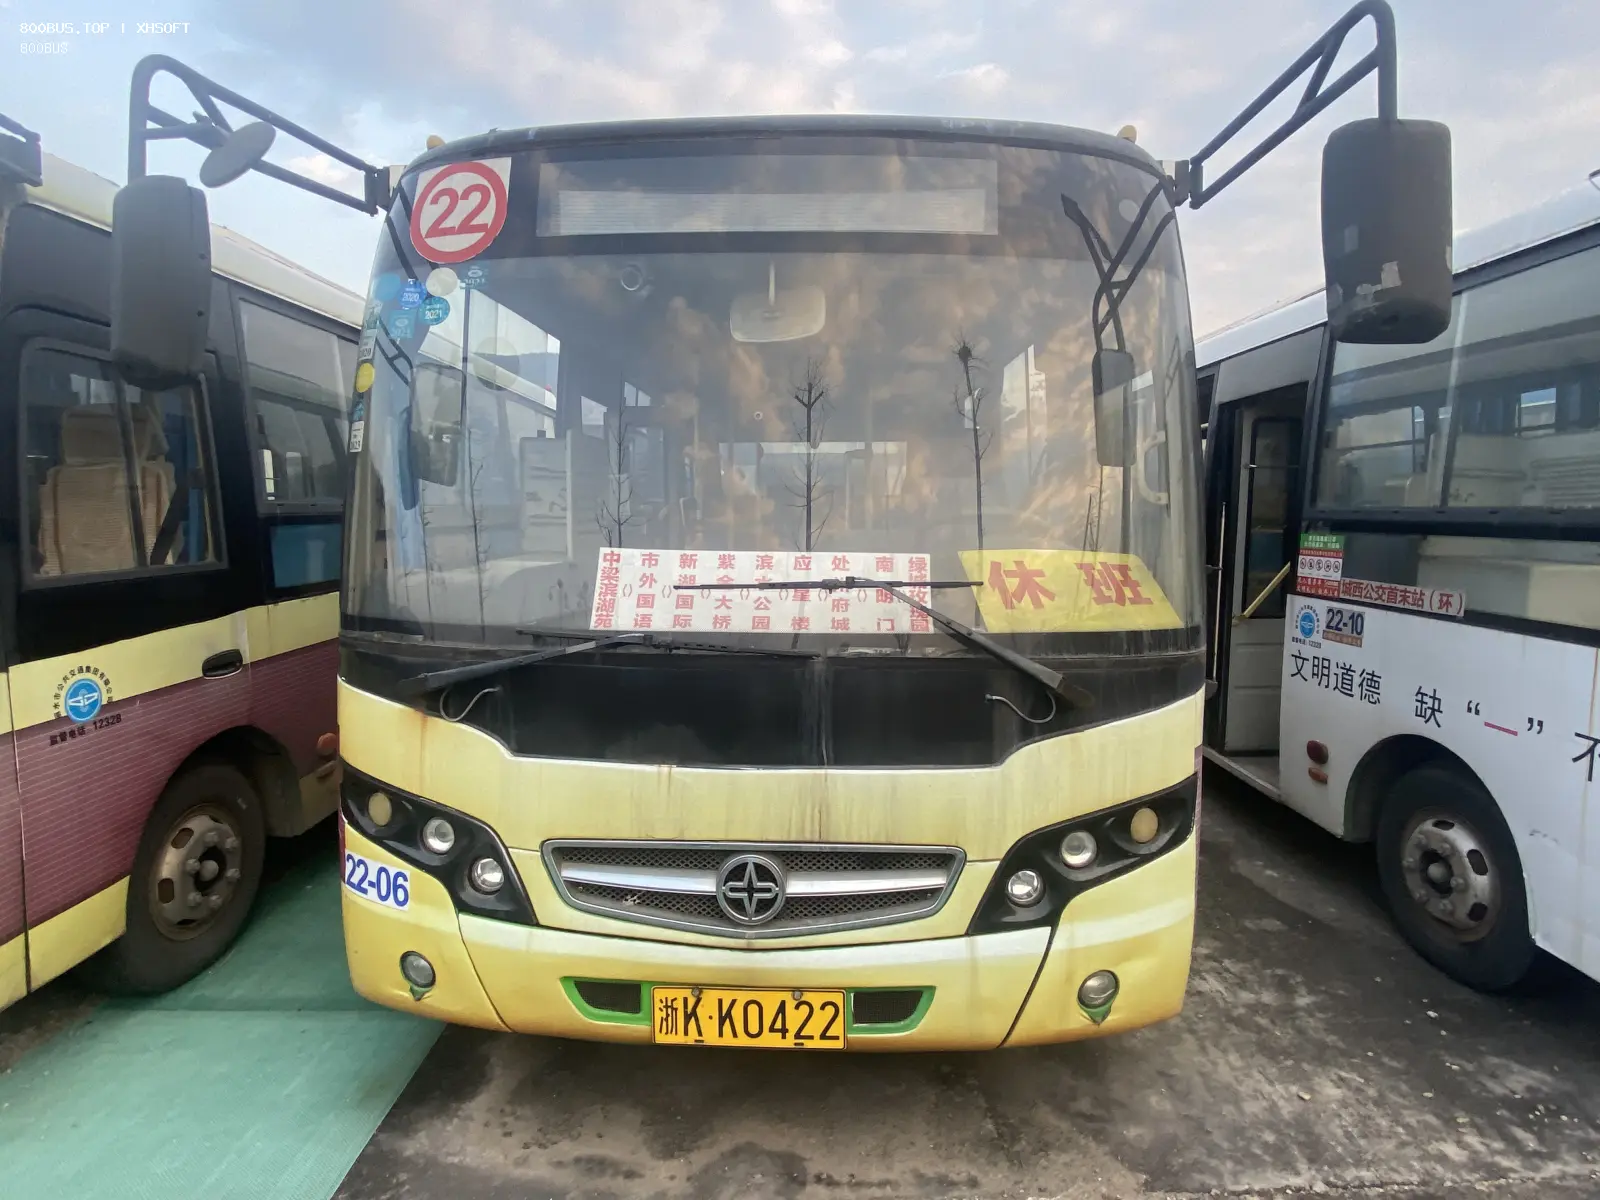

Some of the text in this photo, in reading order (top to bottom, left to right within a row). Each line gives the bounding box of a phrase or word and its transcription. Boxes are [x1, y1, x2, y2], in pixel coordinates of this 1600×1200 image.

[424, 183, 492, 239] 22
[593, 550, 621, 629] 中梁滨湖苑
[633, 552, 660, 630] 市外国语
[672, 553, 698, 629] 新湖国际
[831, 555, 851, 632] 处府城
[987, 560, 1154, 610] 休班
[1325, 608, 1365, 636] 22-10
[1290, 650, 1382, 706] 文明道德
[92, 713, 122, 730] 12328
[346, 853, 409, 907] 22-06
